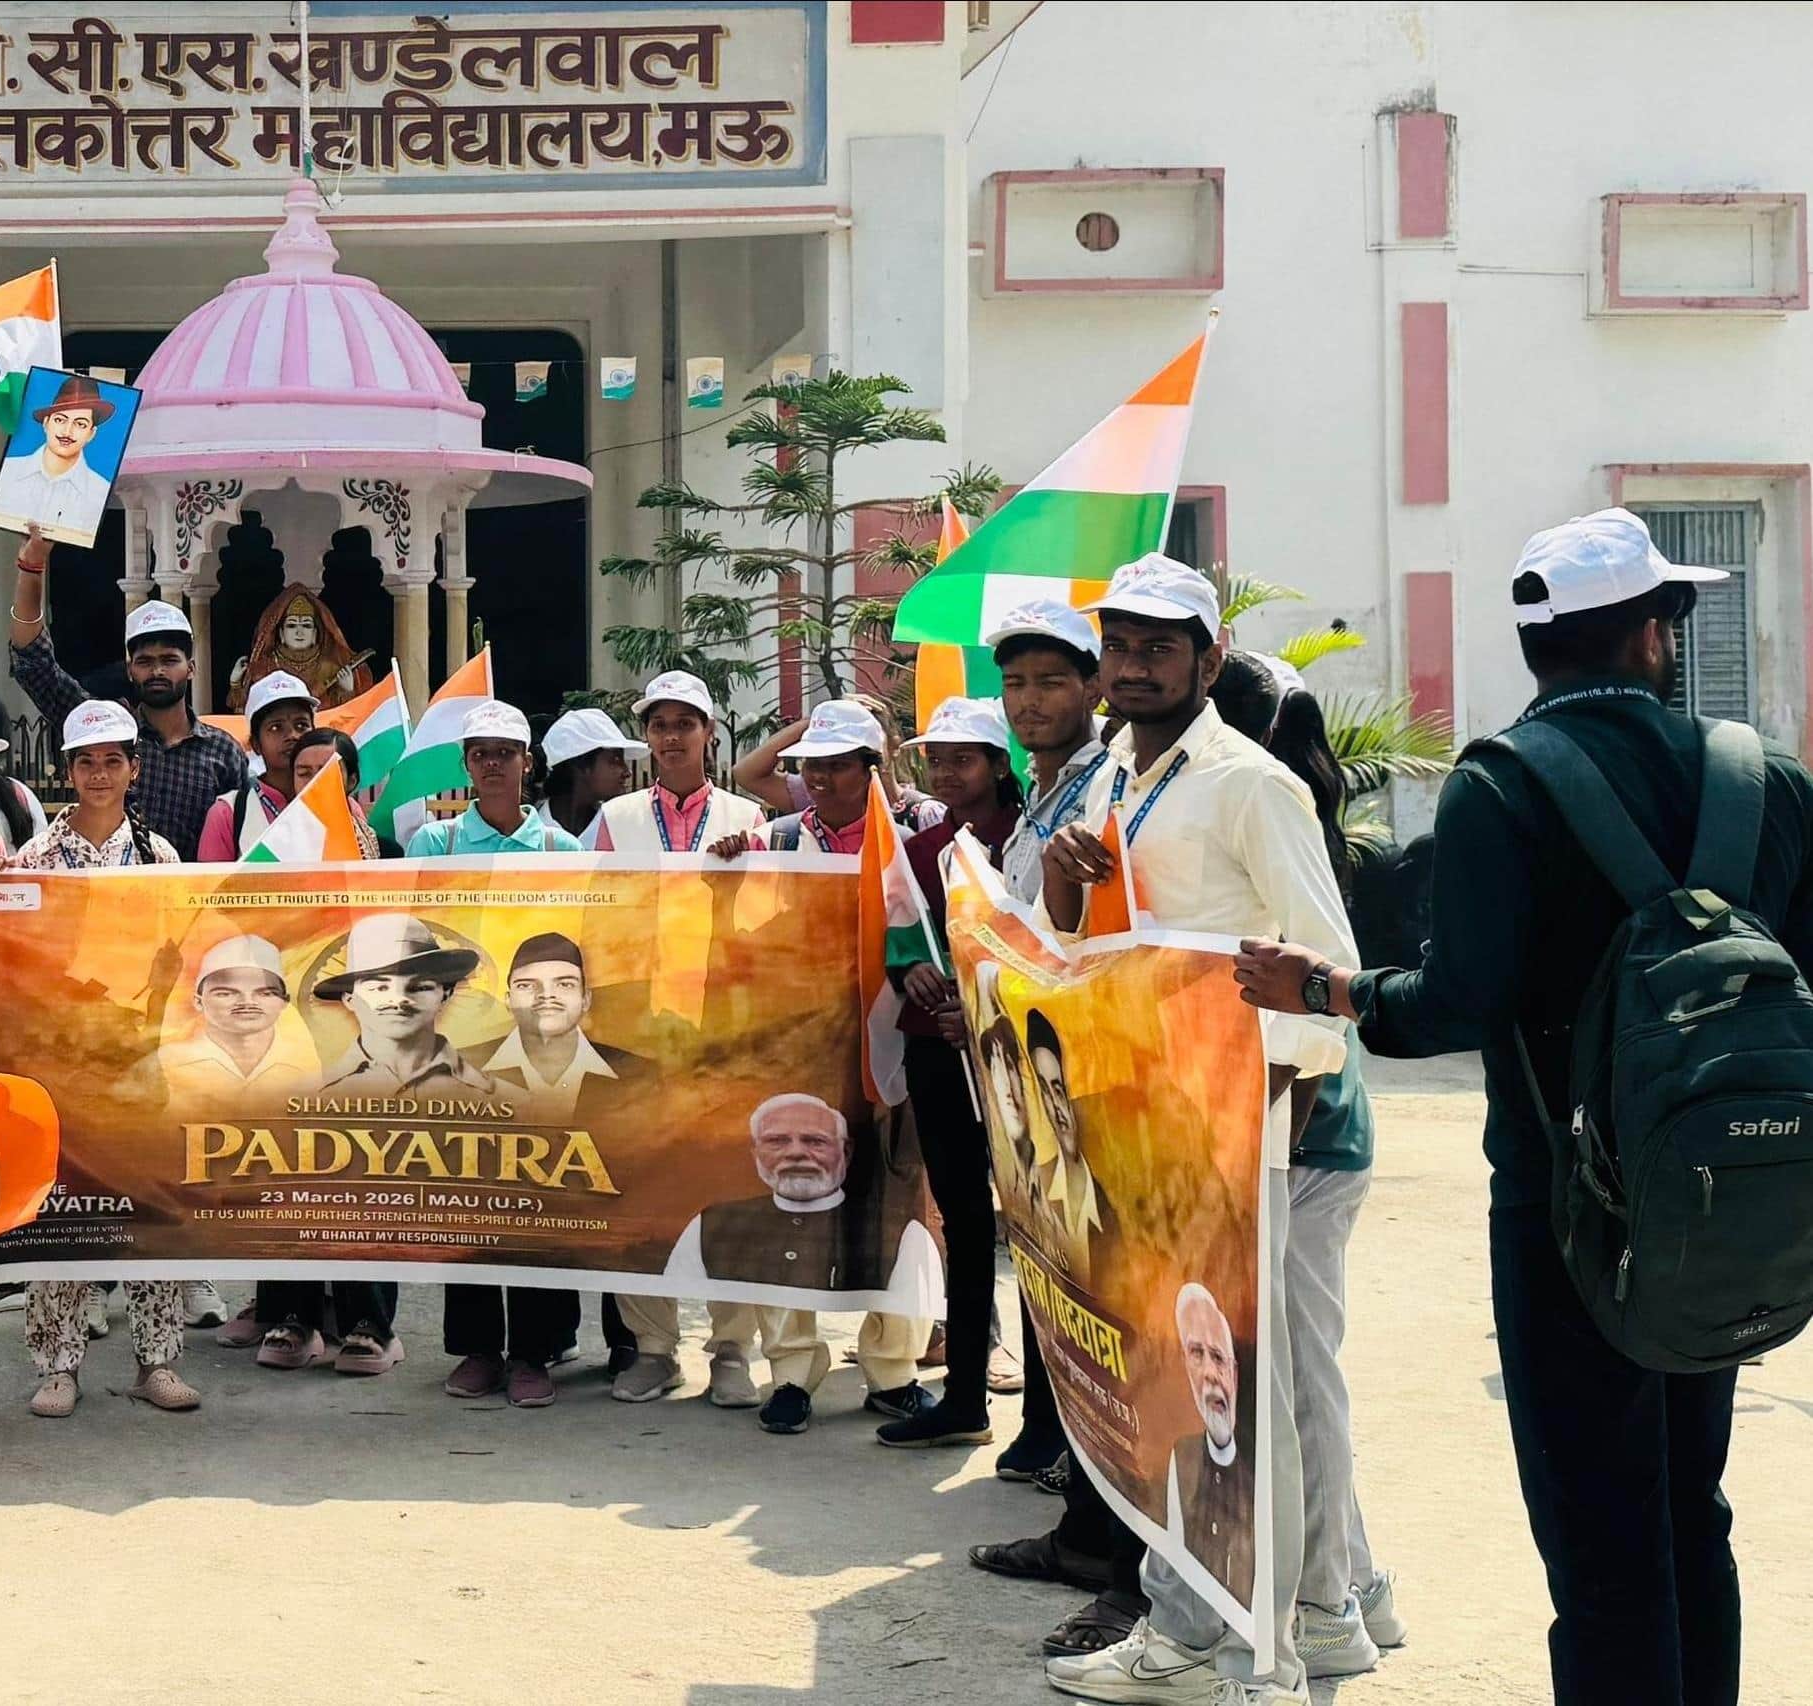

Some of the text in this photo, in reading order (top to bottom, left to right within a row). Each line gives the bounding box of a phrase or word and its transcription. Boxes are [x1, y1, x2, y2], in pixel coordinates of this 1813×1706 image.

[188, 895, 197, 905] A
[200, 895, 273, 905] HEARTFELT
[276, 894, 331, 905] TRIBUTE
[335, 894, 350, 904] TO
[354, 893, 378, 904] THE
[436, 893, 452, 903] OF
[456, 893, 481, 903] THE
[485, 893, 546, 903] FREEDOM
[549, 893, 618, 904] STRUGGLE
[287, 1096, 516, 1119] SHAHEED DIWAS
[1728, 1116, 1801, 1136] safari
[180, 1122, 623, 1196] PADYATRA
[259, 1190, 544, 1213] 23 March 2026 MAU (U.P.)
[194, 1209, 609, 1231] LET US UNITE AND FURTHER STRENGTHEN THE SPIRIT OF PATRIOTISM
[299, 1229, 501, 1246] MY BHARAT MY RESPONSIBILITY
